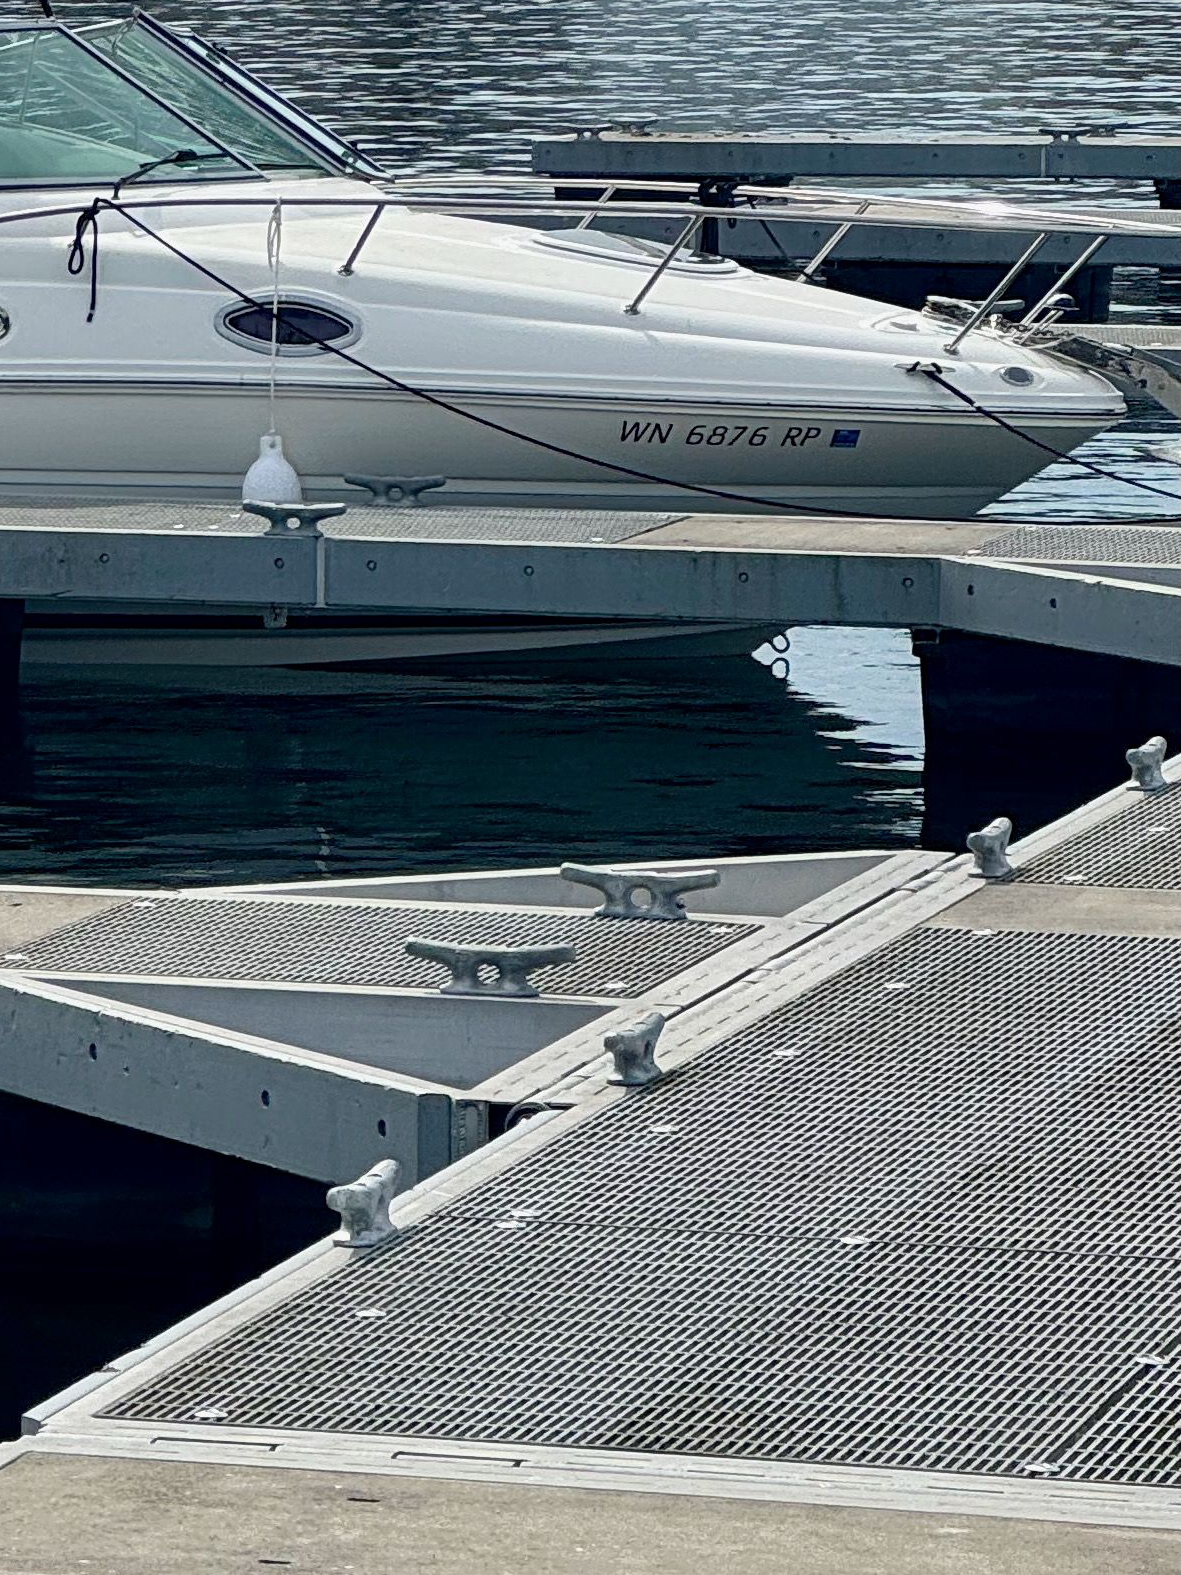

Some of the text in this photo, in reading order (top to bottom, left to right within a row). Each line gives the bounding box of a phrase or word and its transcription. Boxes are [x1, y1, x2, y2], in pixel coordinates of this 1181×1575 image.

[620, 421, 673, 444] WN
[685, 425, 769, 446] 6876
[780, 427, 821, 447] RP
